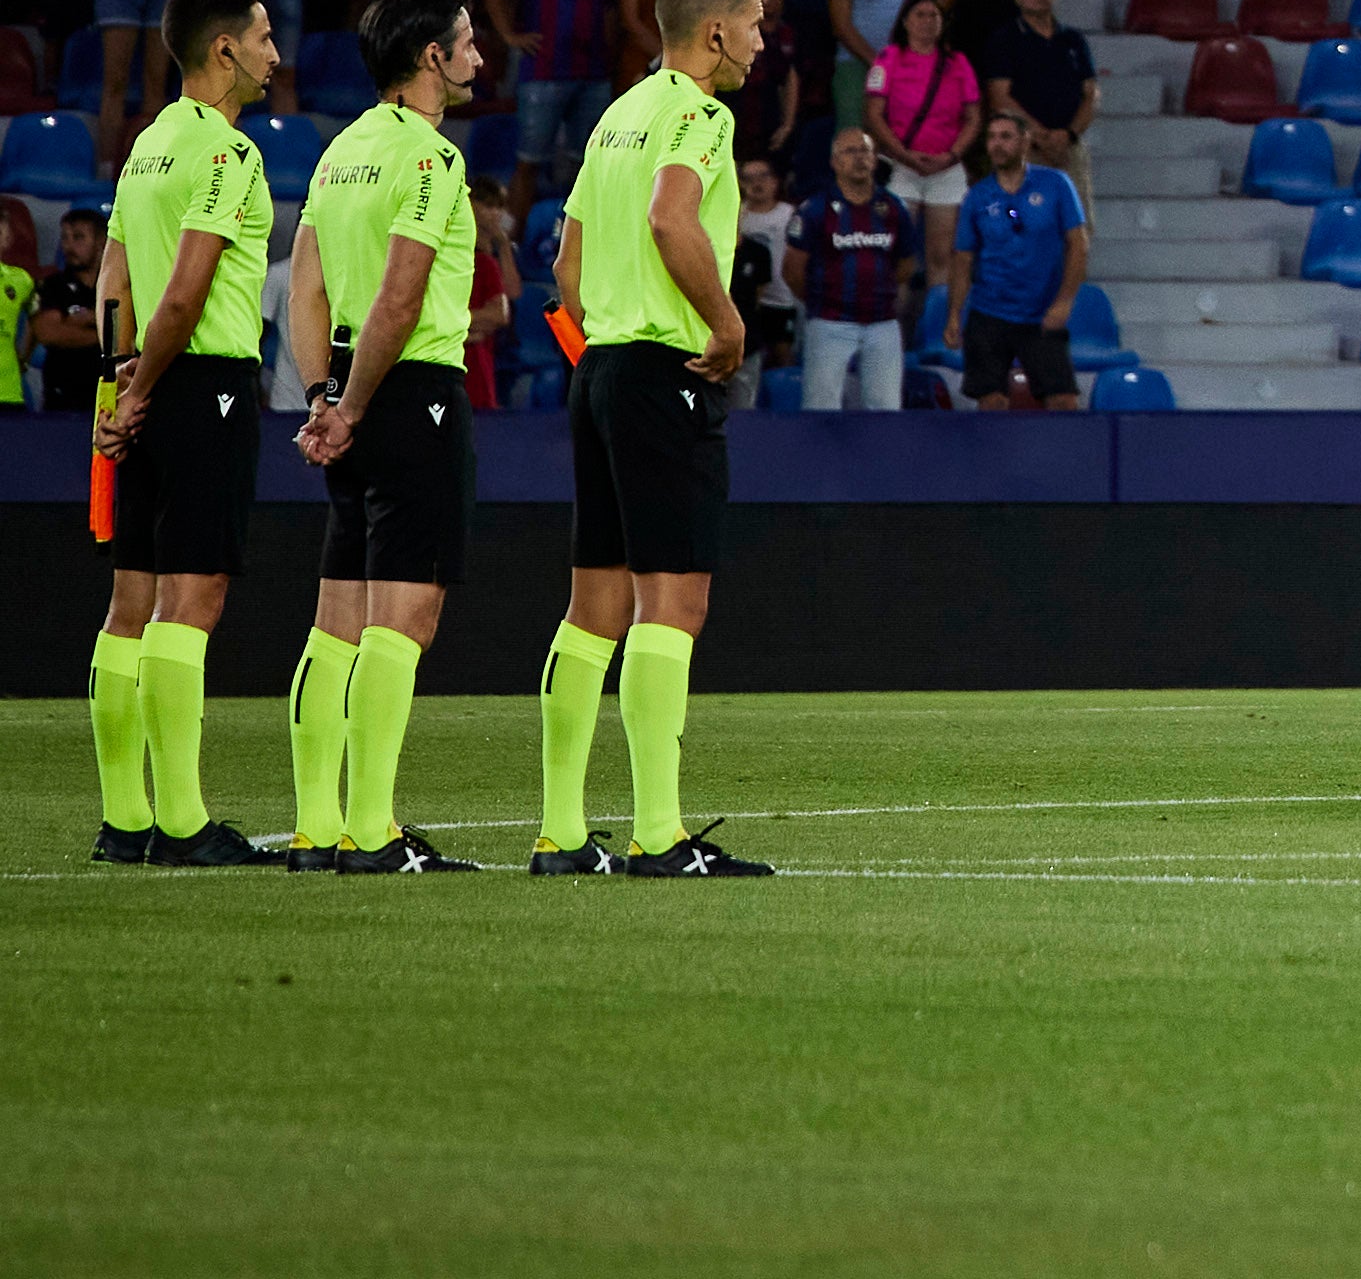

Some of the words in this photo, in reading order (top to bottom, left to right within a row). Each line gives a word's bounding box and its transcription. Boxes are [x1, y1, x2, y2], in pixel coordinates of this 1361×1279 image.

[599, 129, 648, 150] WÜRTH
[131, 156, 175, 176] WÜRTH
[330, 165, 381, 185] WÜRTH
[203, 166, 225, 214] WÜRTH
[413, 173, 432, 222] WÜRTH
[831, 231, 893, 251] betway
